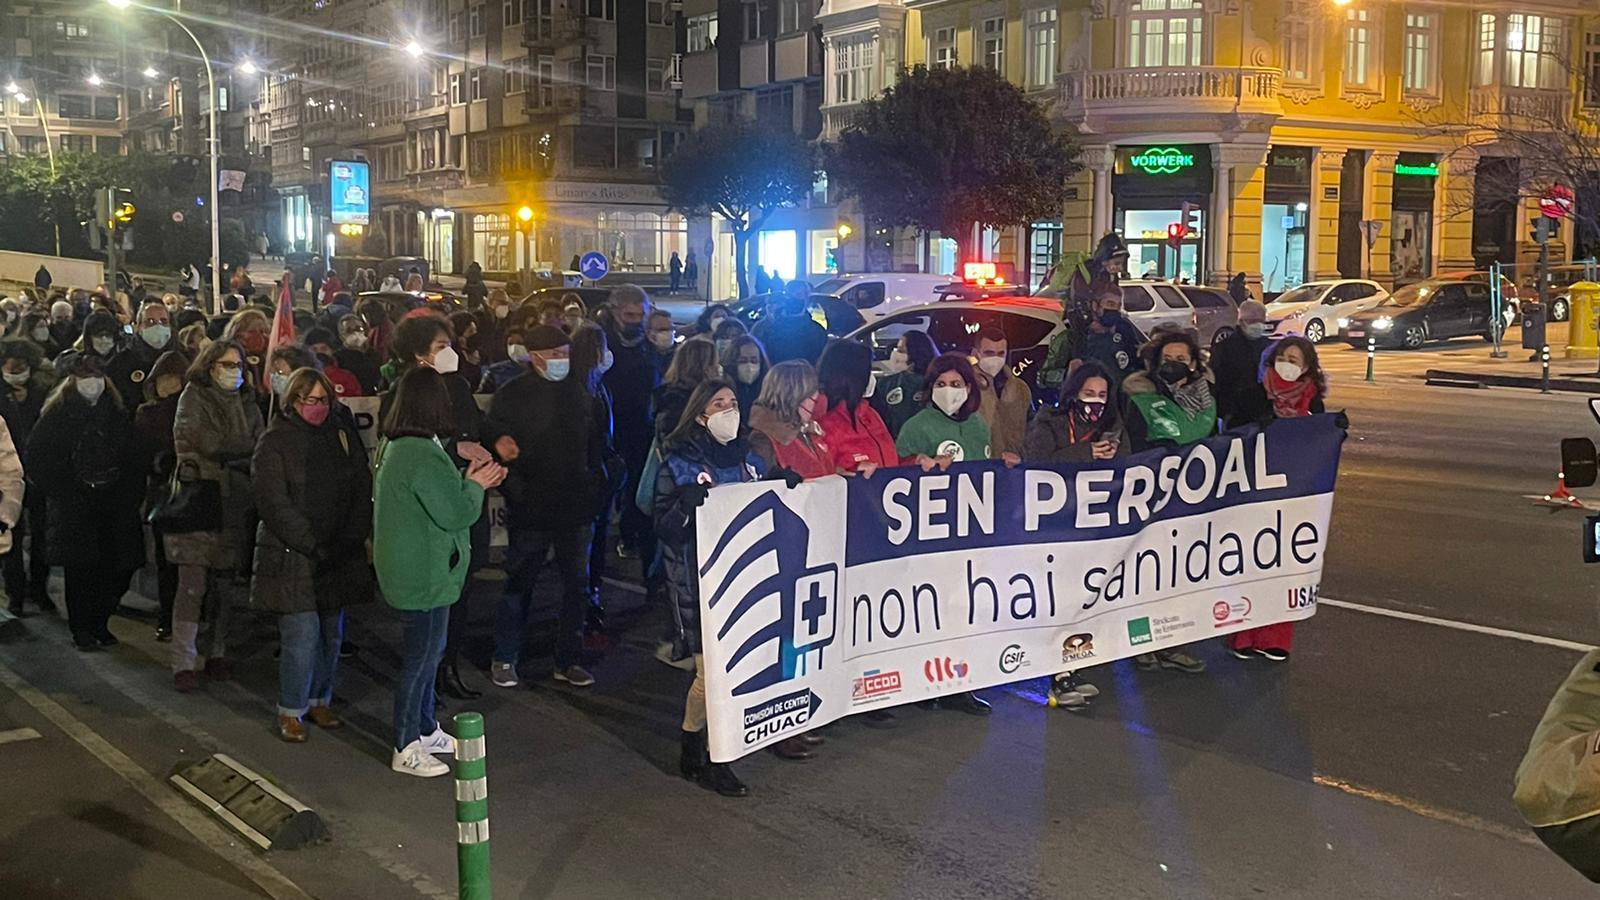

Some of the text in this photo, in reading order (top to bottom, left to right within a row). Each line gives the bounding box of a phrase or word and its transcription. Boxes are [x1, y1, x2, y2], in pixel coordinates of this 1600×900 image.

[1131, 155, 1194, 167] VORWERK
[882, 432, 1288, 545] SEN PERSOAL
[852, 510, 1319, 647] non hai sanidade
[1004, 651, 1026, 664] CSIF
[774, 703, 783, 714] DE
[783, 695, 809, 710] CENTRO
[744, 711, 808, 744] CHUAC
